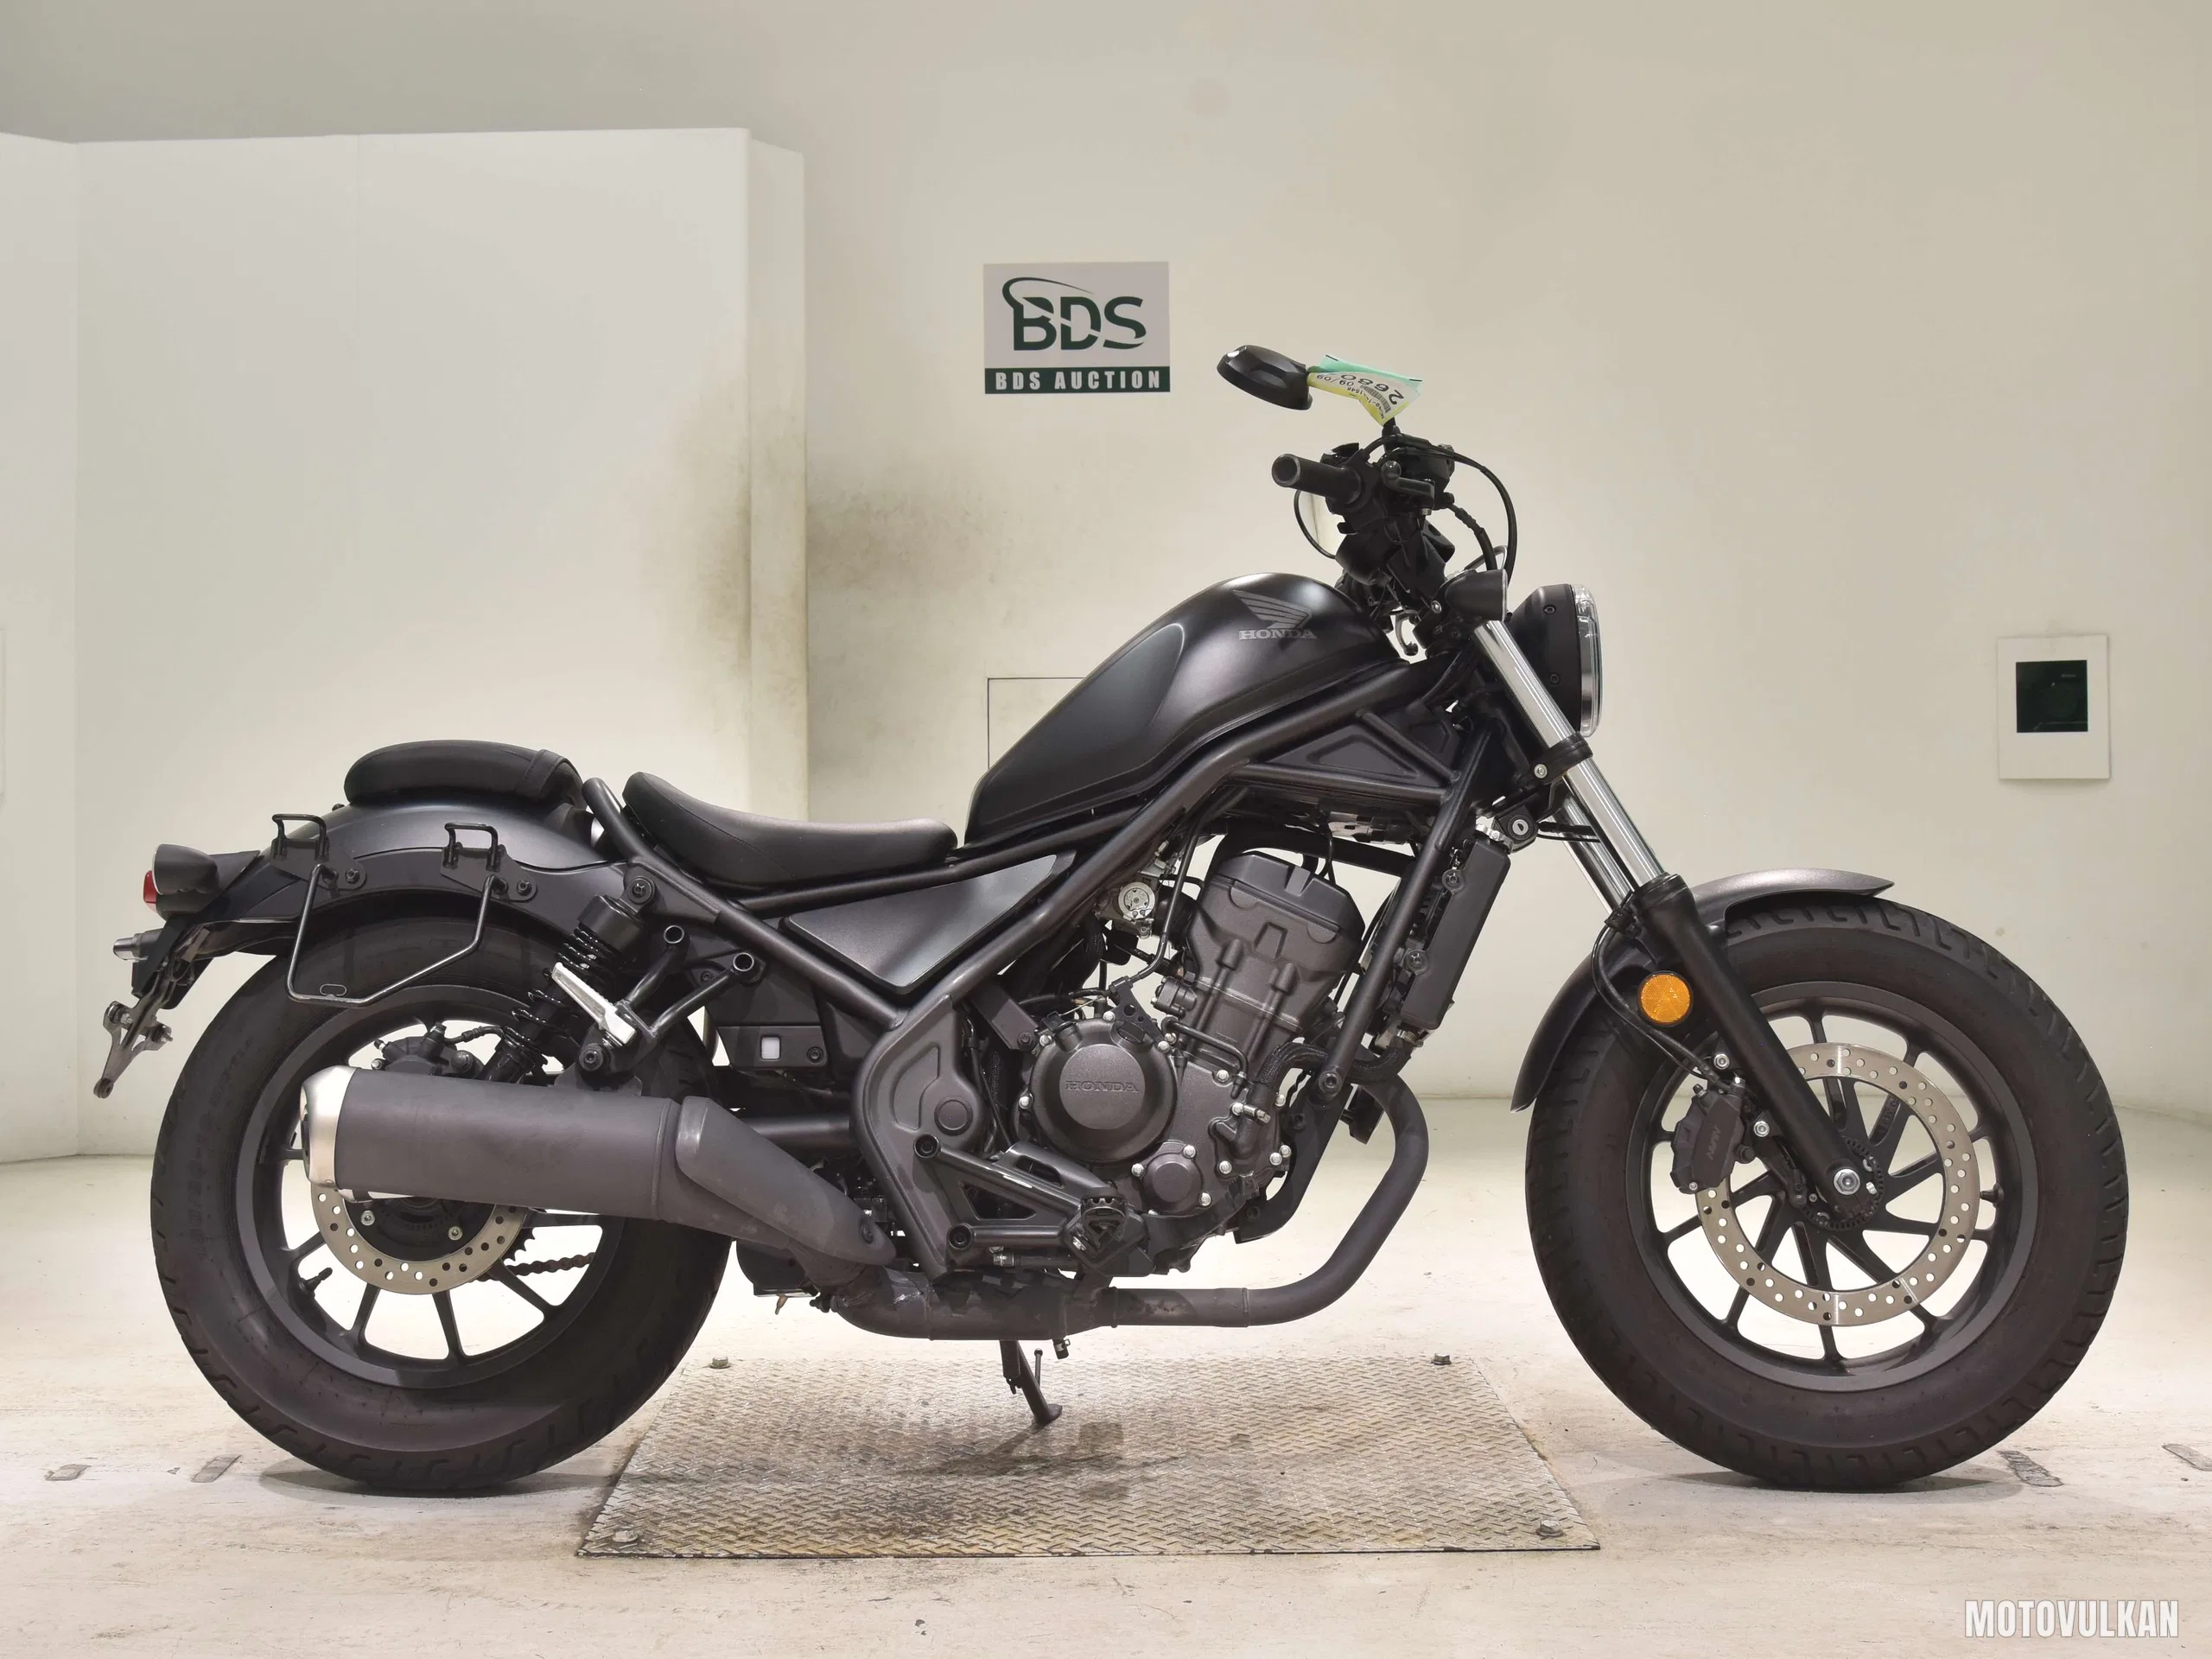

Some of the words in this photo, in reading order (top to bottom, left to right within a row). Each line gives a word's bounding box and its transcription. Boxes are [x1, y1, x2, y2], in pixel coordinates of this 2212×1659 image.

[1002, 277, 1147, 351] BDS
[995, 372, 1040, 390] BDS
[1054, 370, 1160, 389] AUCTION
[1238, 629, 1317, 640] HONDA
[1065, 1080, 1139, 1093] HONDA
